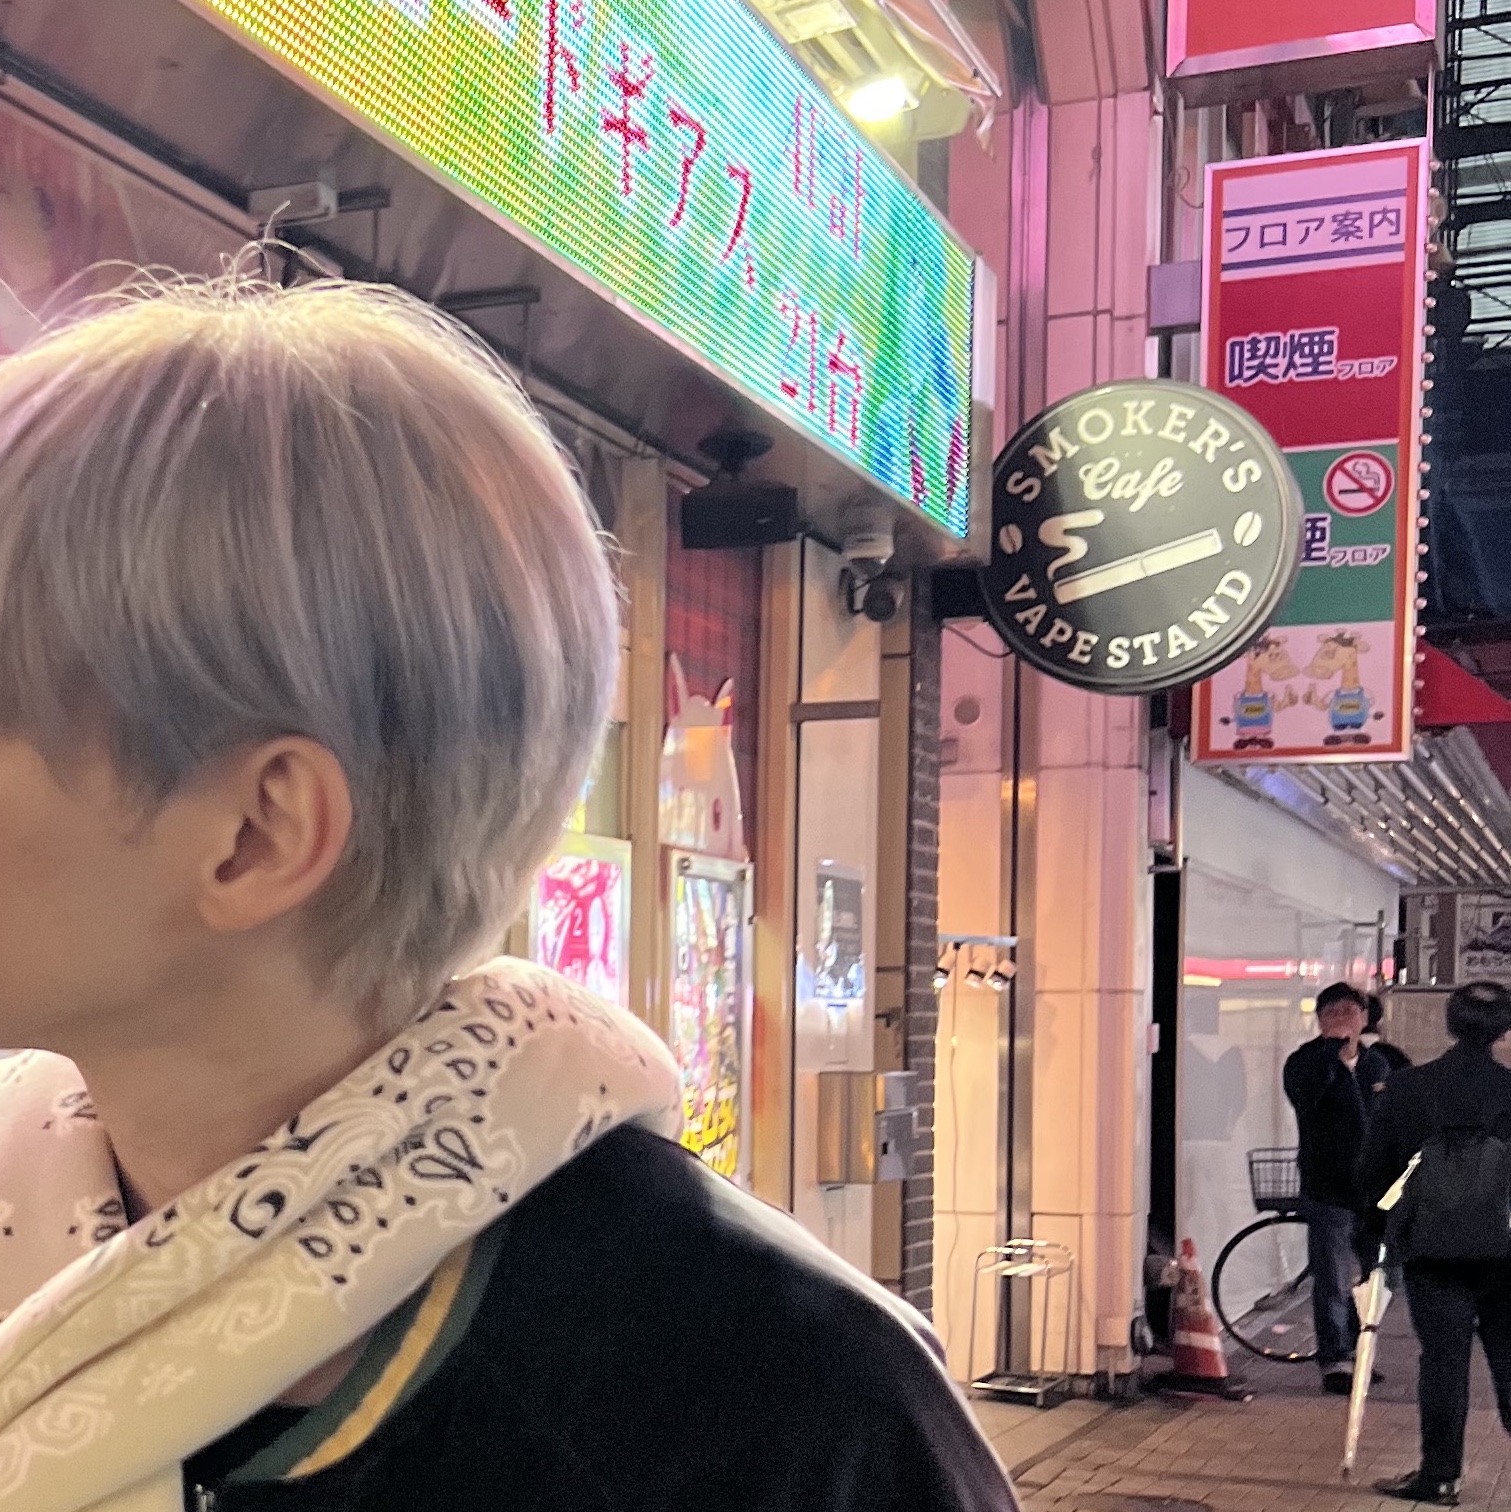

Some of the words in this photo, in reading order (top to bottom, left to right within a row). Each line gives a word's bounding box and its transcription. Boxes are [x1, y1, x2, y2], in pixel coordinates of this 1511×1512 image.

[1225, 205, 1401, 252] フロア案内
[1005, 400, 1263, 503] SMOKER'S
[1078, 456, 1185, 513] Cafe
[1004, 573, 1100, 664] VAPE
[1106, 569, 1253, 669] STAND
